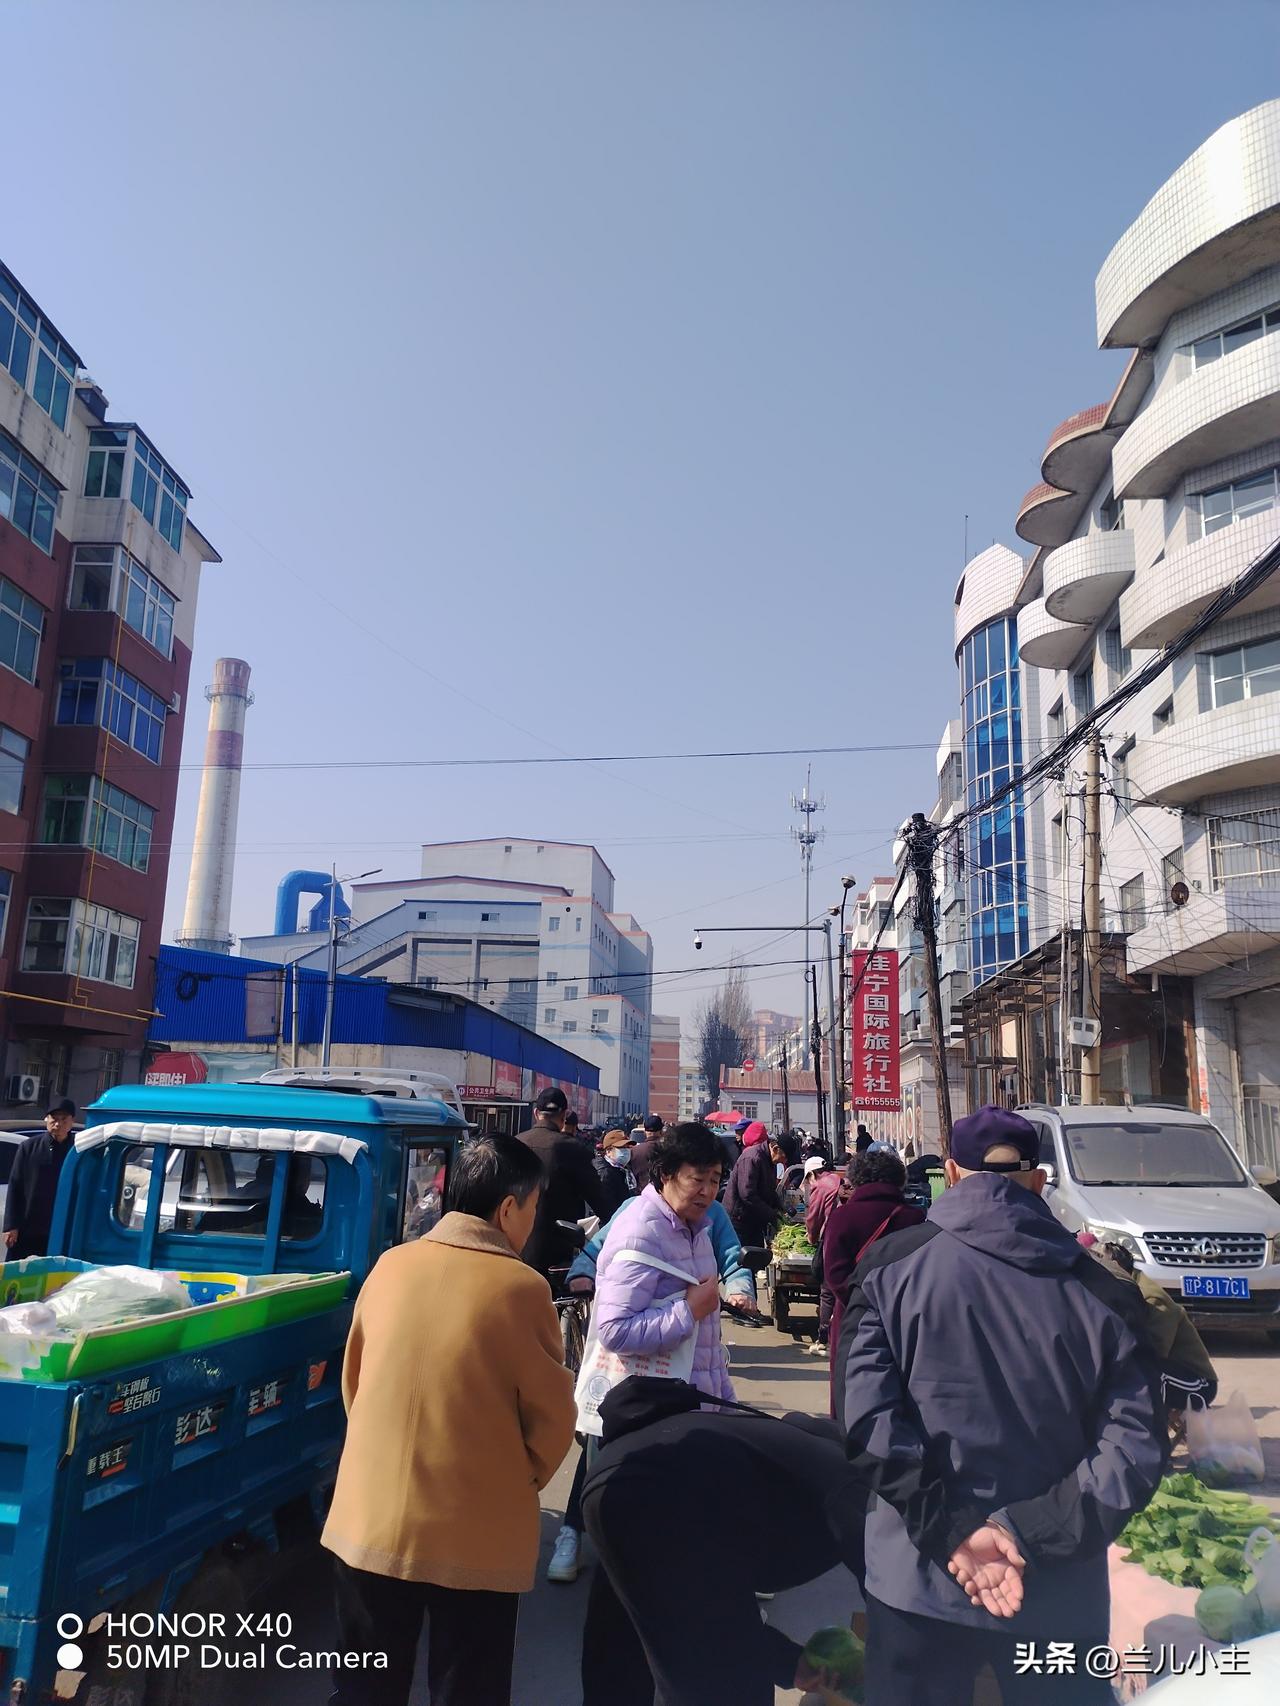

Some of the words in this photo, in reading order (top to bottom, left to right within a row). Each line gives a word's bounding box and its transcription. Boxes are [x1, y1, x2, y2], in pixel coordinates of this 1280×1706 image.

[863, 954, 891, 1093] 佳宁国际旅行社
[864, 1096, 900, 1107] 6155555
[87, 1445, 124, 1476] 重载王
